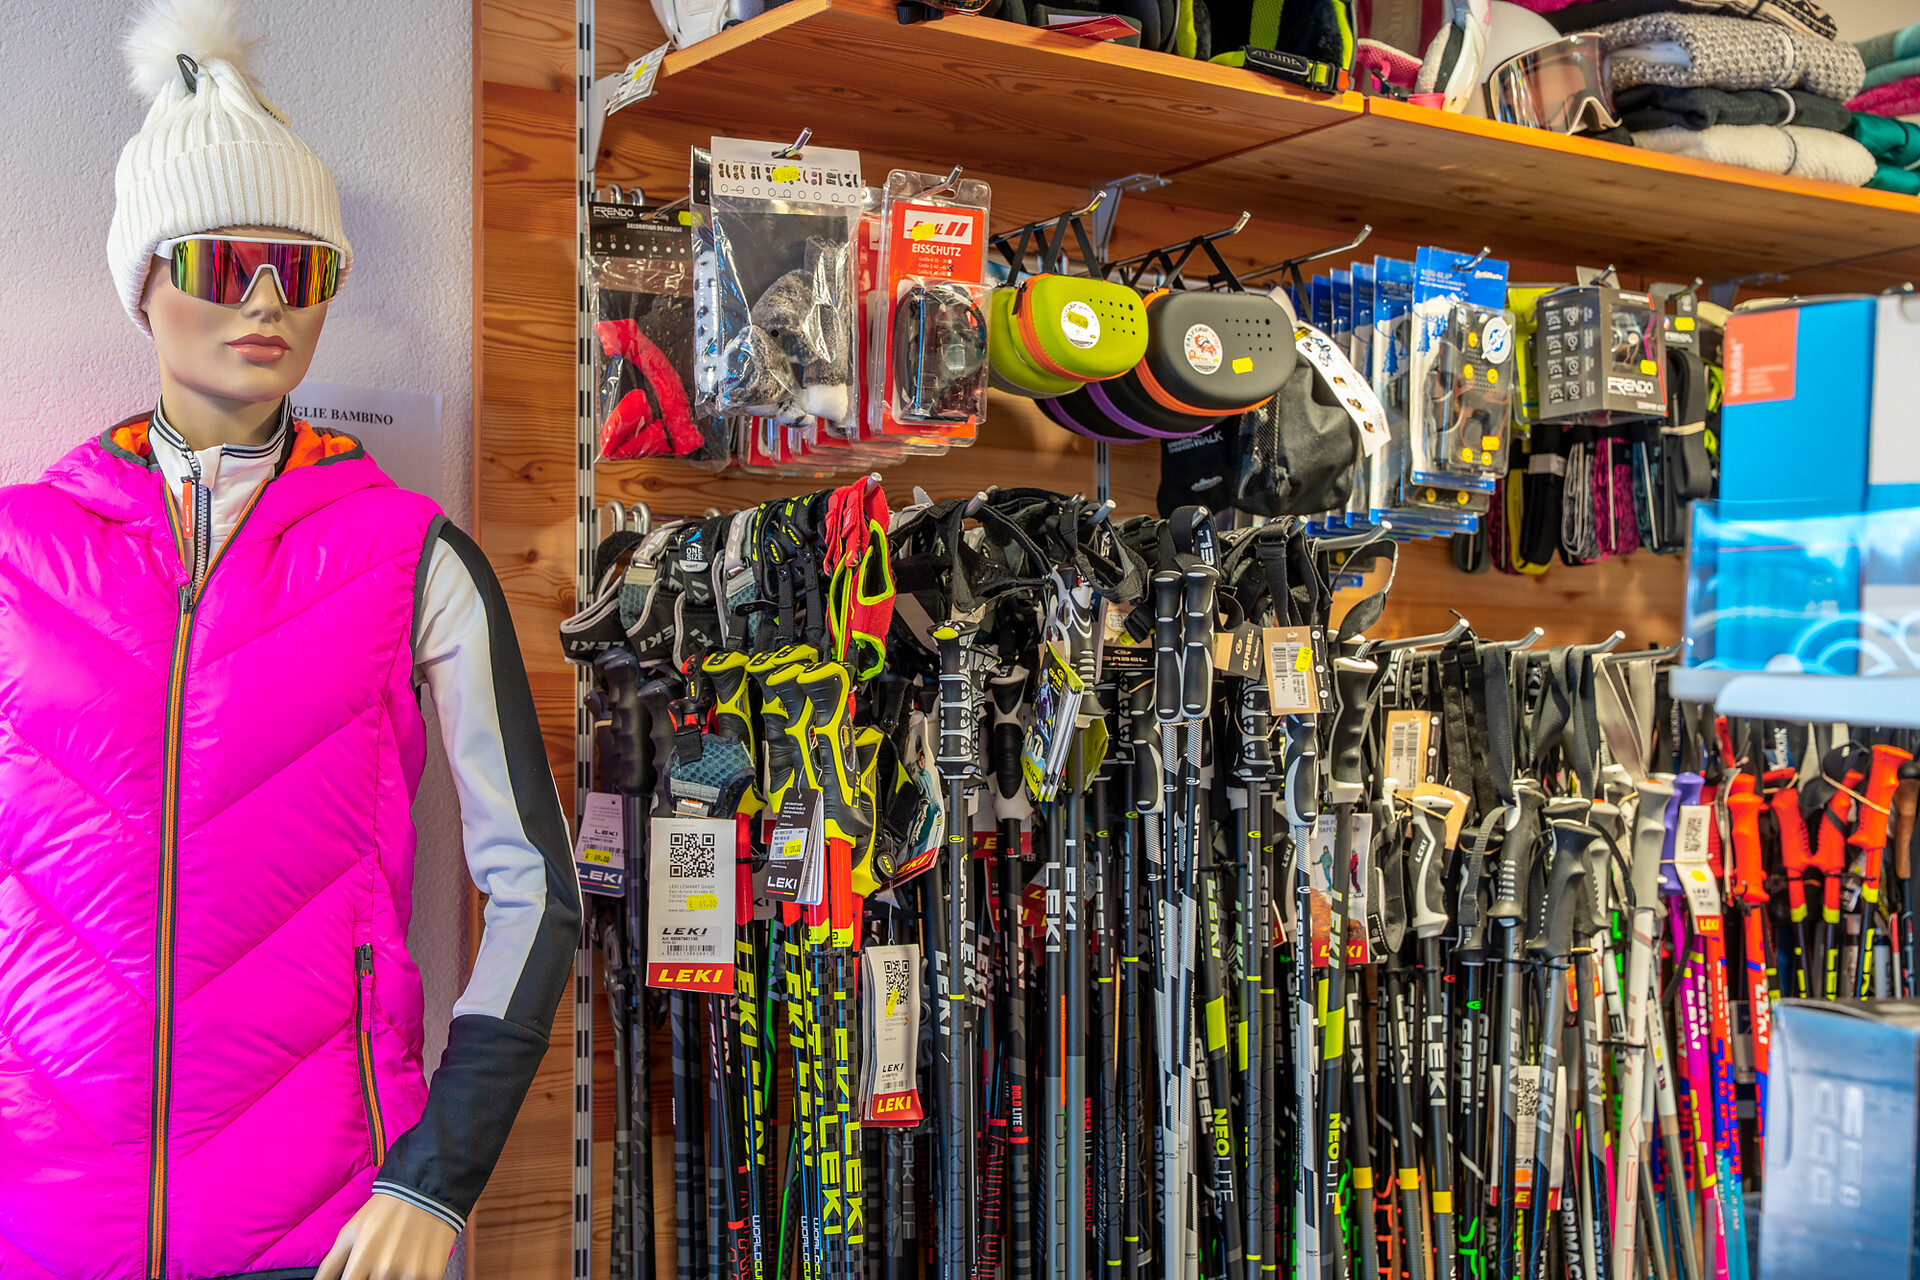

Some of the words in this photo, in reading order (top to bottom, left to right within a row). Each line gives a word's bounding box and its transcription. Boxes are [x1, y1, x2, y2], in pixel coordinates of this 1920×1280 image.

[592, 206, 635, 219] FRENDO
[911, 243, 962, 257] EISSCHUTZ
[292, 406, 328, 419] GLIE
[331, 408, 394, 426] BAMBINO
[1607, 377, 1655, 395] FRENDO
[1193, 429, 1224, 447] WALK
[686, 547, 703, 555] ONE
[639, 624, 675, 653] EKI
[1241, 629, 1255, 671] GABEL
[852, 770, 861, 809] LEKI
[594, 829, 619, 837] LEKI
[895, 854, 928, 875] EKI
[1281, 843, 1294, 868] LEKI
[1414, 839, 1428, 864] LEKI
[577, 867, 623, 885] LEKI
[767, 876, 798, 890] LEKI
[1046, 862, 1061, 953] LEKI
[1064, 839, 1077, 931] LEKI
[662, 928, 708, 936] LEKI
[1207, 878, 1222, 959] LEKI
[1319, 944, 1362, 959] LKI
[1327, 889, 1343, 970] LEKI
[1700, 919, 1720, 931] LEKI
[657, 969, 724, 983] LEKI
[736, 940, 758, 1048] LEKI
[784, 940, 805, 1049] LEKI
[935, 950, 951, 1036] LEKI
[975, 933, 991, 1009] LEKI
[1346, 992, 1366, 1084] LEKI
[1396, 994, 1412, 1085] LEKI
[1508, 1007, 1521, 1095] LEKI
[1685, 988, 1702, 1050] LEKI
[881, 1062, 905, 1073] LEKI
[1194, 1037, 1214, 1135] GABEL
[1426, 1015, 1447, 1106] LEKI
[1460, 1017, 1473, 1114] GABEL
[1537, 1044, 1558, 1134] LEKI
[1584, 1019, 1604, 1106] LEKI
[877, 1095, 912, 1114] LEKI
[819, 1115, 842, 1235] LEKI
[845, 1121, 864, 1245] LEKI
[902, 1132, 915, 1239] ARKLITE
[1213, 1108, 1234, 1203] NEOLITE
[1325, 1112, 1341, 1206] NEOLITE
[752, 1214, 764, 1280] WORLDCU
[1562, 1198, 1584, 1280] PRIMAC
